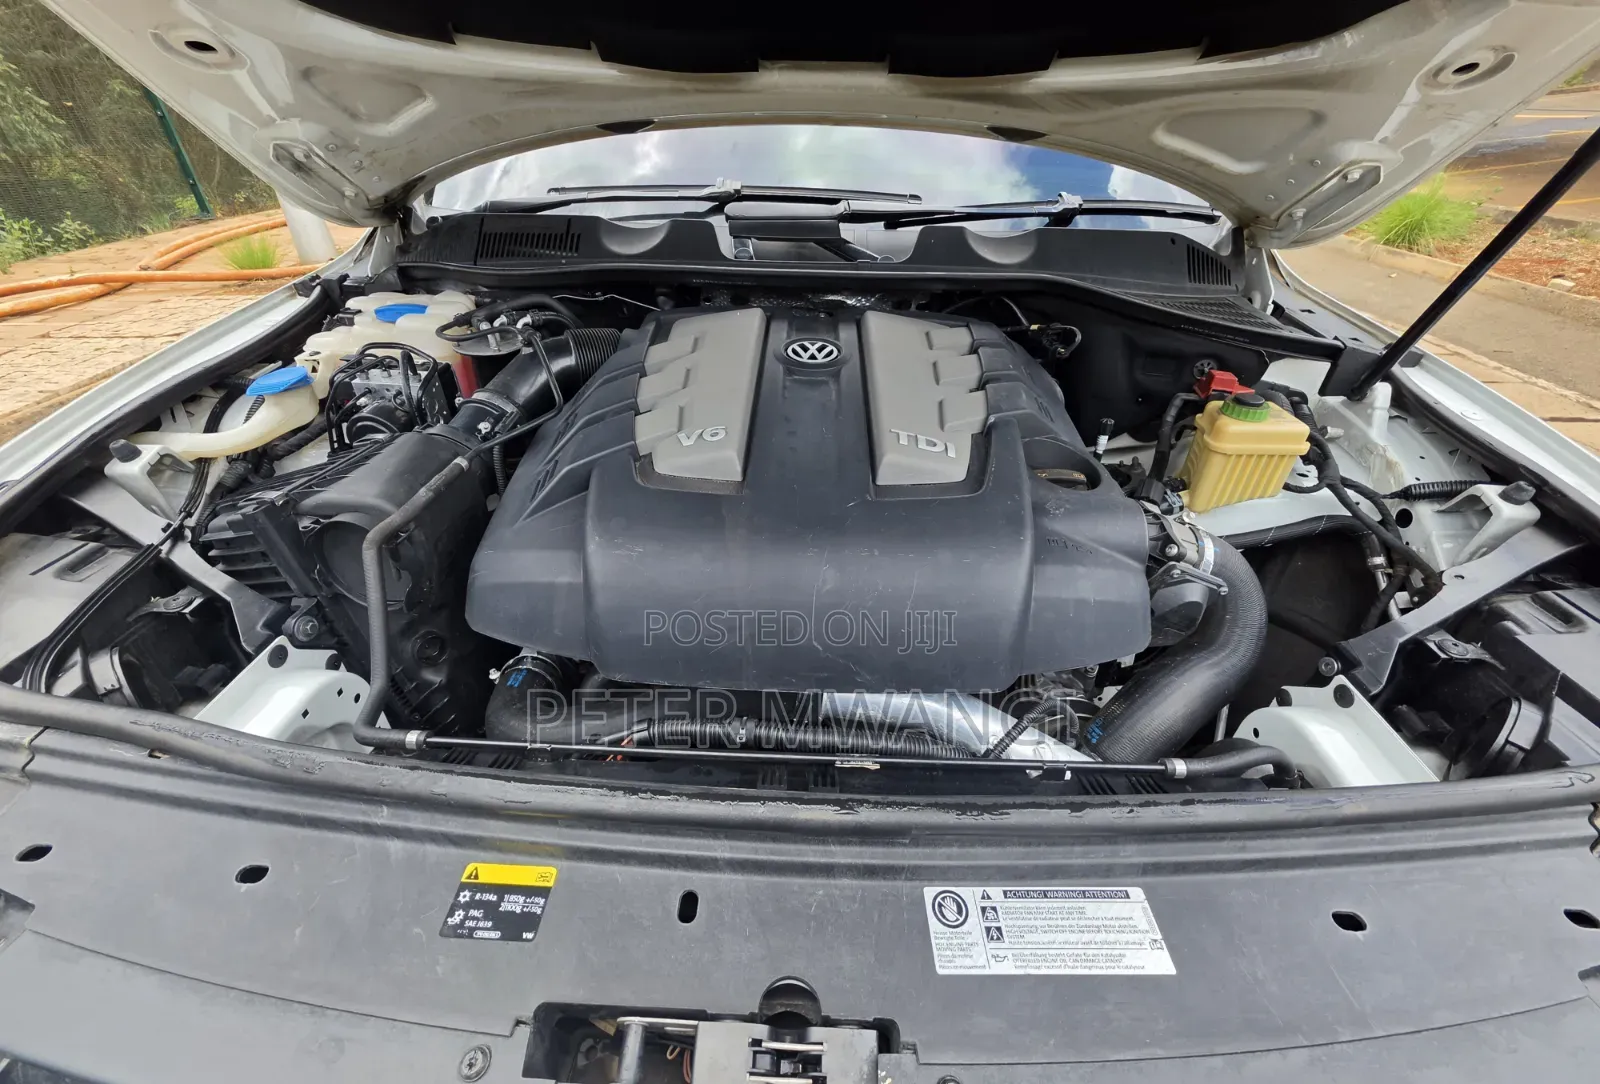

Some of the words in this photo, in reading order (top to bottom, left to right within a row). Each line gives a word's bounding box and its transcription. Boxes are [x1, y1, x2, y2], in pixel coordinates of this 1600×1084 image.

[676, 425, 728, 448] V6
[890, 428, 957, 459] TDI
[474, 892, 498, 902] R-134a
[1006, 890, 1045, 899] ACHTUNG!
[1045, 890, 1084, 899] WARNING!
[1085, 890, 1127, 899] ATTENTION!
[467, 909, 484, 917] PAG
[464, 919, 477, 927] SAE
